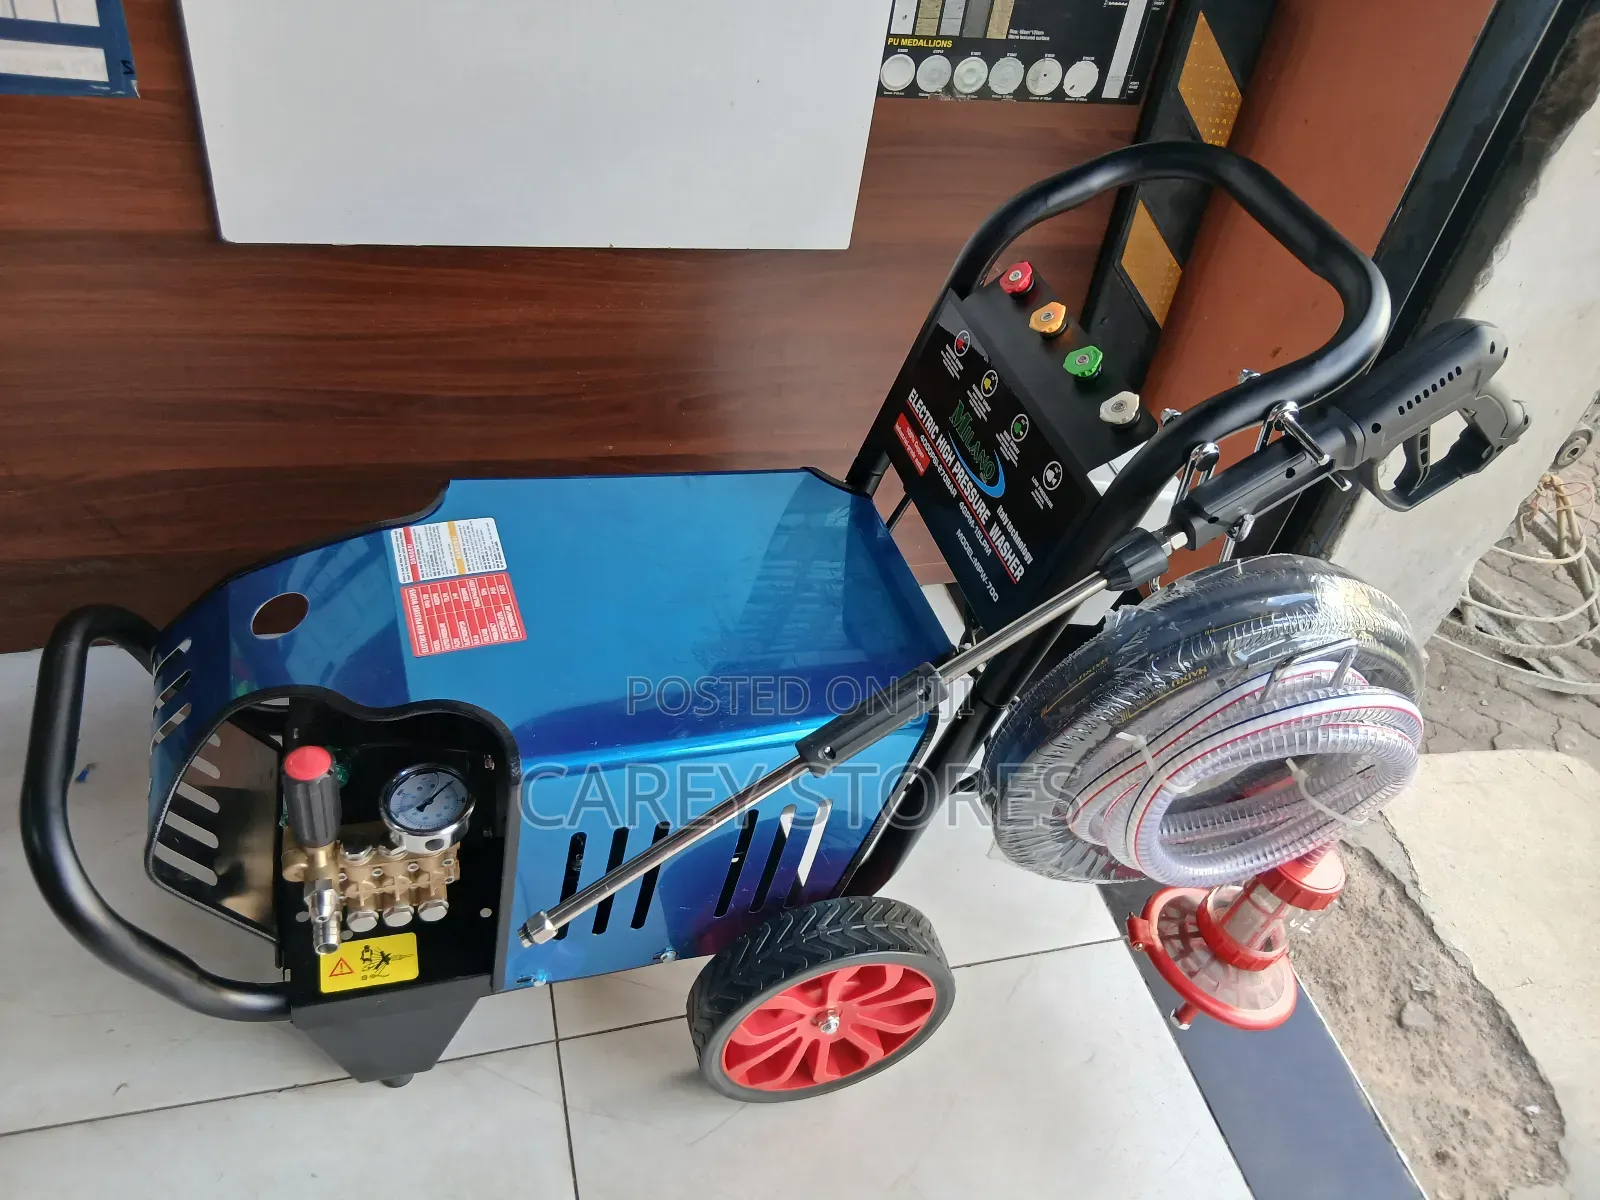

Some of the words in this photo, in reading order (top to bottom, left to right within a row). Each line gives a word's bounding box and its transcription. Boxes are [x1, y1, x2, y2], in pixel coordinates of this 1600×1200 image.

[887, 37, 899, 46] PU
[900, 38, 953, 48] MEDALLIONS
[948, 399, 997, 480] MILANO
[906, 387, 939, 440] ELECTRIC
[934, 435, 954, 465] HIGH
[951, 462, 990, 524] PRESSURE
[988, 523, 1025, 581] WASHER
[996, 504, 1009, 525] Italy
[958, 501, 991, 555] 4GPM-15LPM
[954, 528, 1000, 602] MODEL:MPW-700
